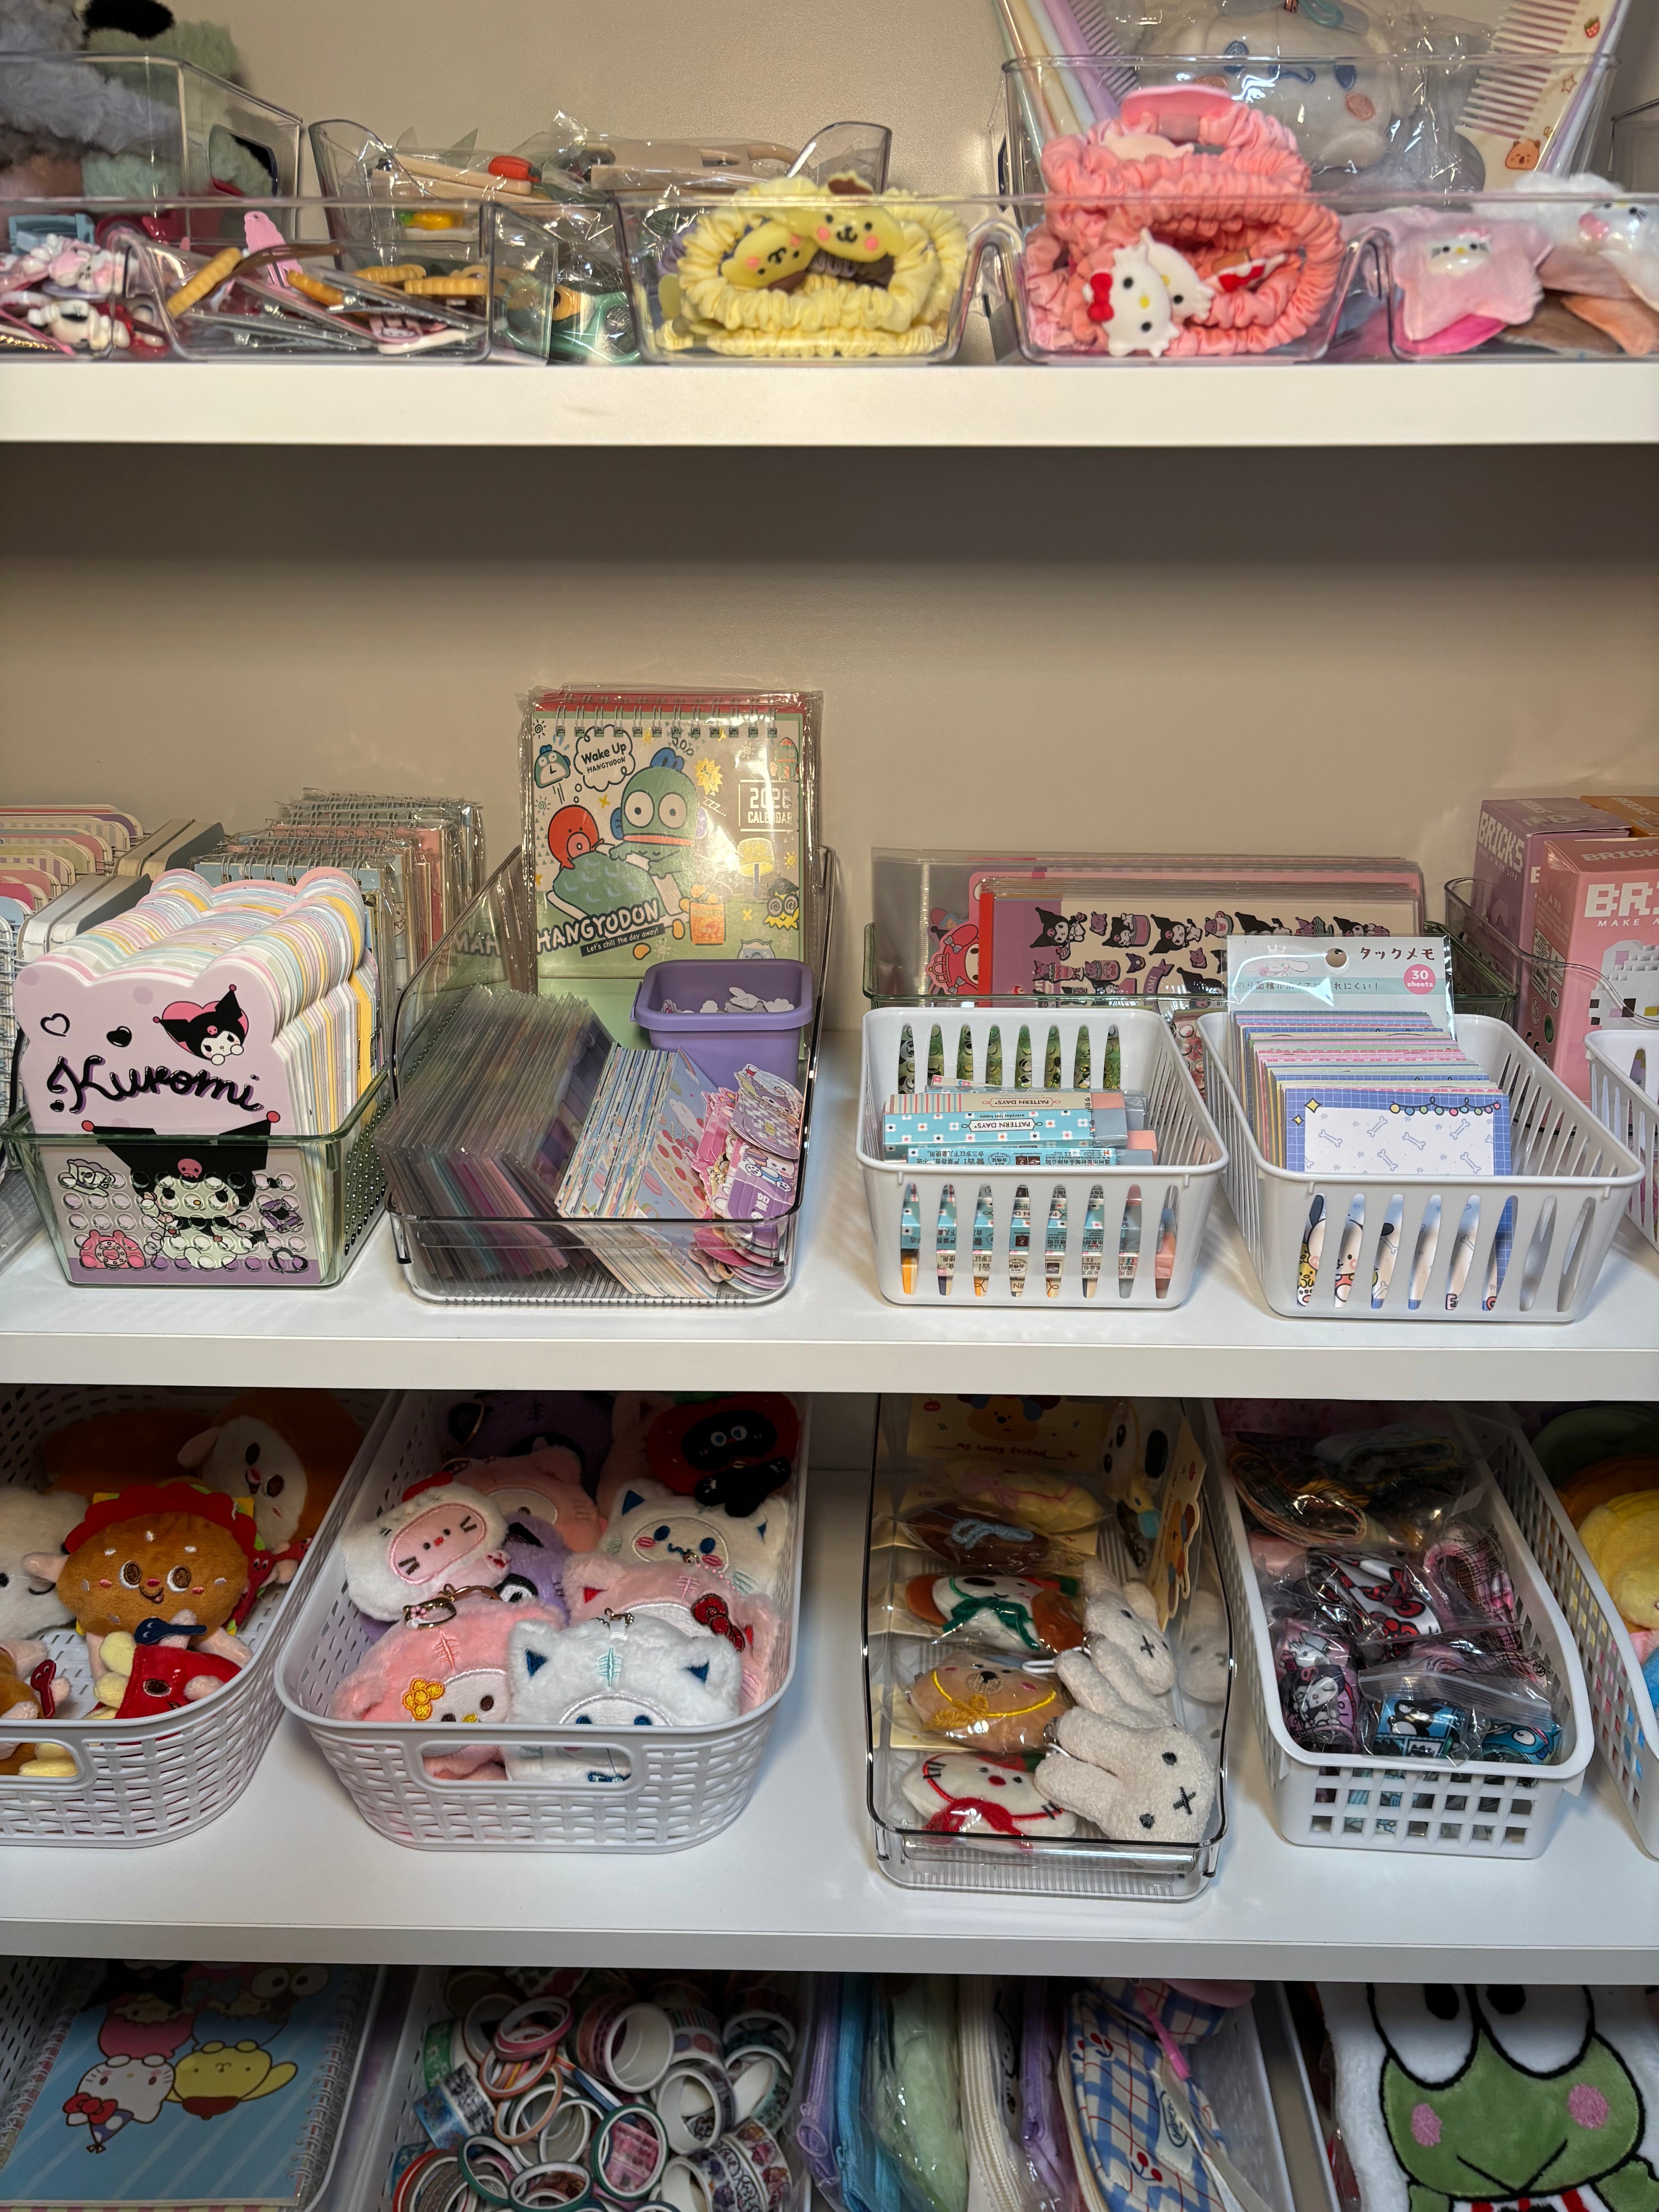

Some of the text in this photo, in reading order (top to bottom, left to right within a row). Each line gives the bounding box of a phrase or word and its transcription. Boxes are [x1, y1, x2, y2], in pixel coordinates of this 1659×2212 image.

[581, 742, 626, 764] Wake Up
[587, 756, 625, 774] HANGYODON
[750, 788, 791, 809] 2026
[748, 811, 792, 824] CALEDAR
[1478, 811, 1525, 874] BRICKS
[1581, 849, 1659, 861] BRICK
[537, 899, 660, 954] HANGYODON
[1597, 918, 1640, 927] MAKE
[586, 943, 602, 953] Let's
[603, 939, 616, 948] chill
[642, 927, 659, 938] away!
[1360, 947, 1435, 960] タックメモ
[1411, 970, 1429, 980] 30
[1146, 976, 1157, 993] OMI
[47, 1055, 264, 1114] Kuromi
